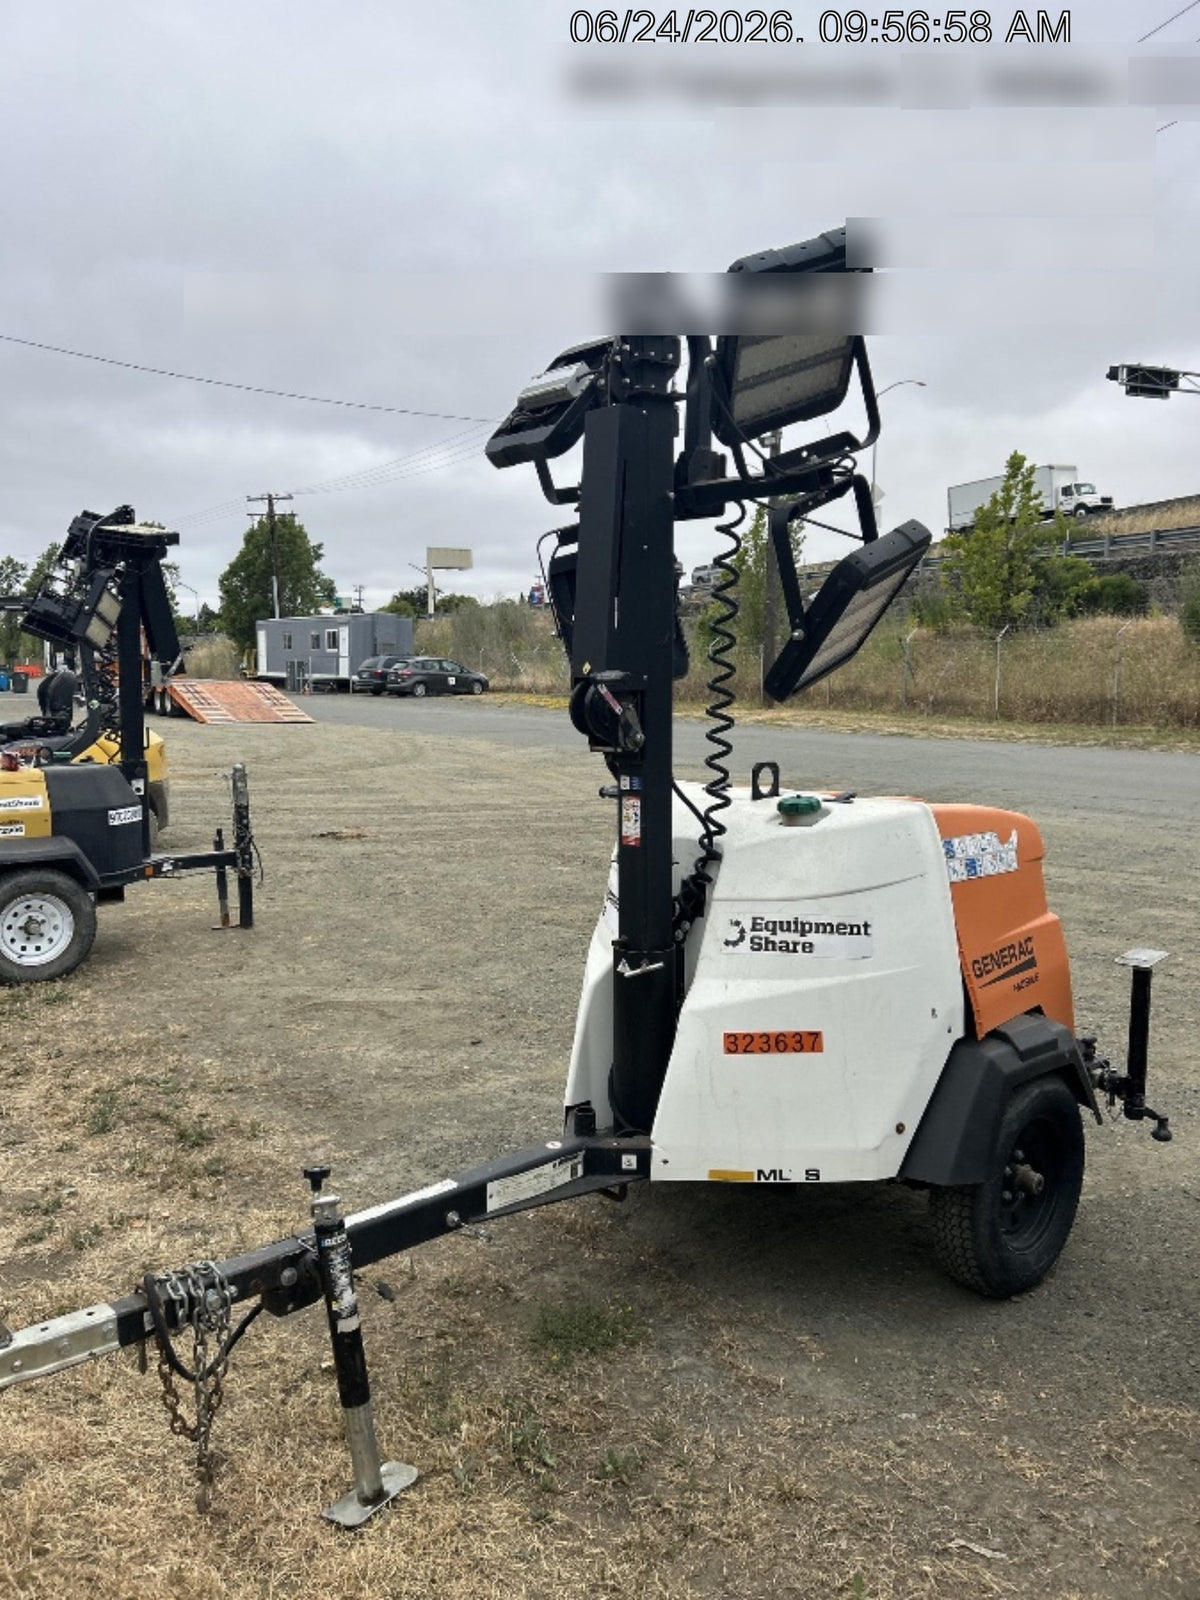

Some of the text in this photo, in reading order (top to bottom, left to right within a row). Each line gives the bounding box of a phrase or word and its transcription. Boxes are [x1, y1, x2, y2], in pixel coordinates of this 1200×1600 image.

[751, 917, 871, 937] Equipment
[750, 936, 815, 954] Share
[972, 936, 1034, 979] GENERAC
[726, 1032, 820, 1053] 323637
[757, 1169, 820, 1181] MLS
